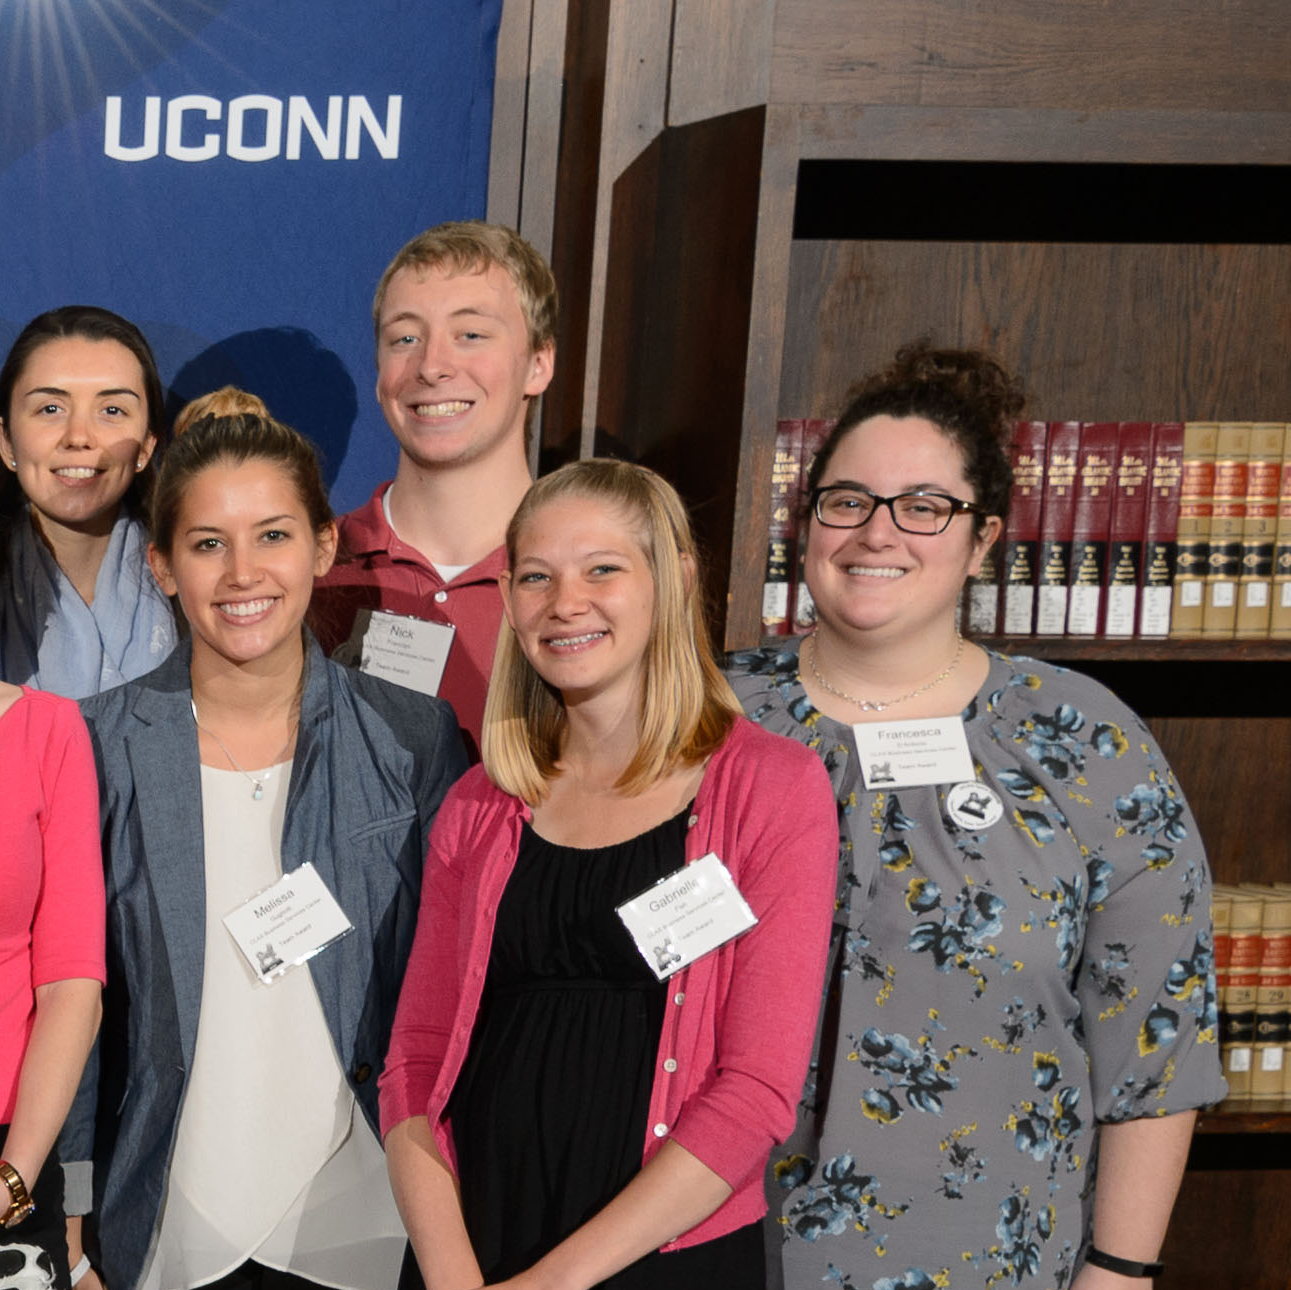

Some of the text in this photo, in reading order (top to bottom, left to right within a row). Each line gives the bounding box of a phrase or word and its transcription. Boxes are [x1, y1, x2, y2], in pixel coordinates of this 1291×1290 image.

[105, 95, 402, 162] UCONN
[390, 625, 414, 640] Nick
[878, 728, 941, 741] Francesca
[253, 889, 295, 919] Melissa
